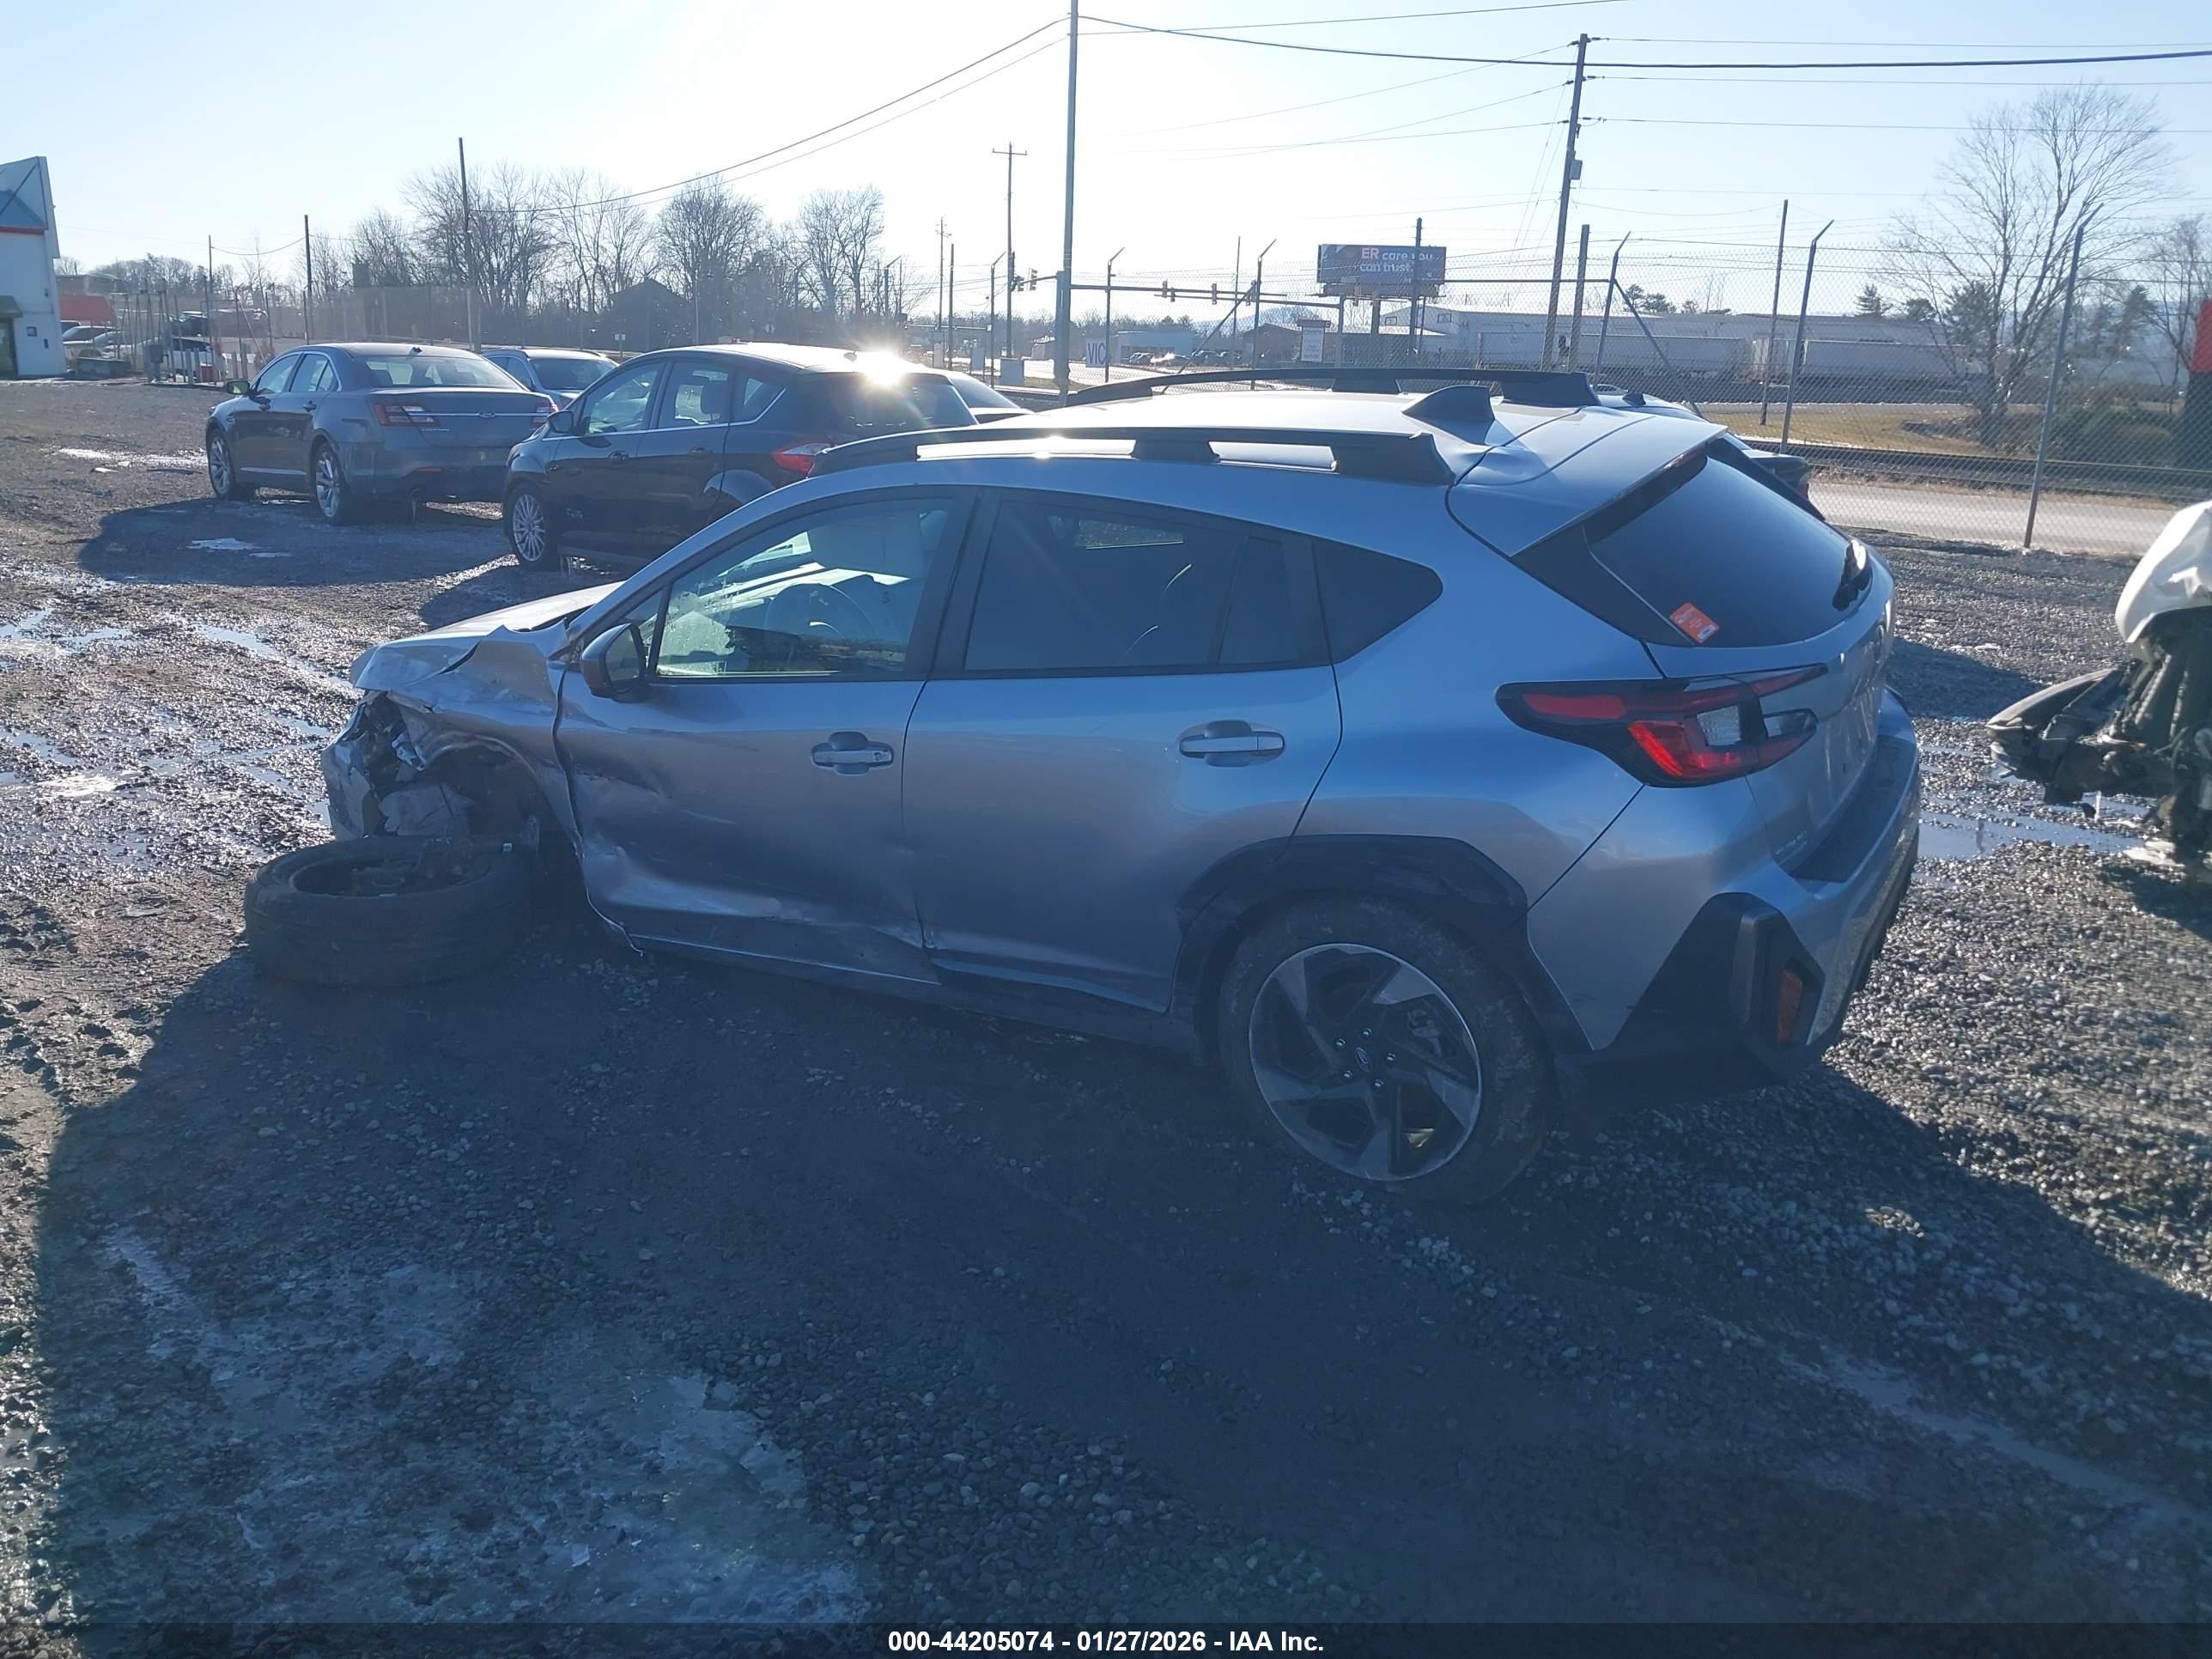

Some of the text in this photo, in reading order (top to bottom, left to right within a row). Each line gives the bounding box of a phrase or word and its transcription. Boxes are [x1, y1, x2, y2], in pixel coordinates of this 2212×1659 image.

[1361, 247, 1380, 259] ER
[1382, 252, 1408, 261] care
[1359, 263, 1381, 272] can
